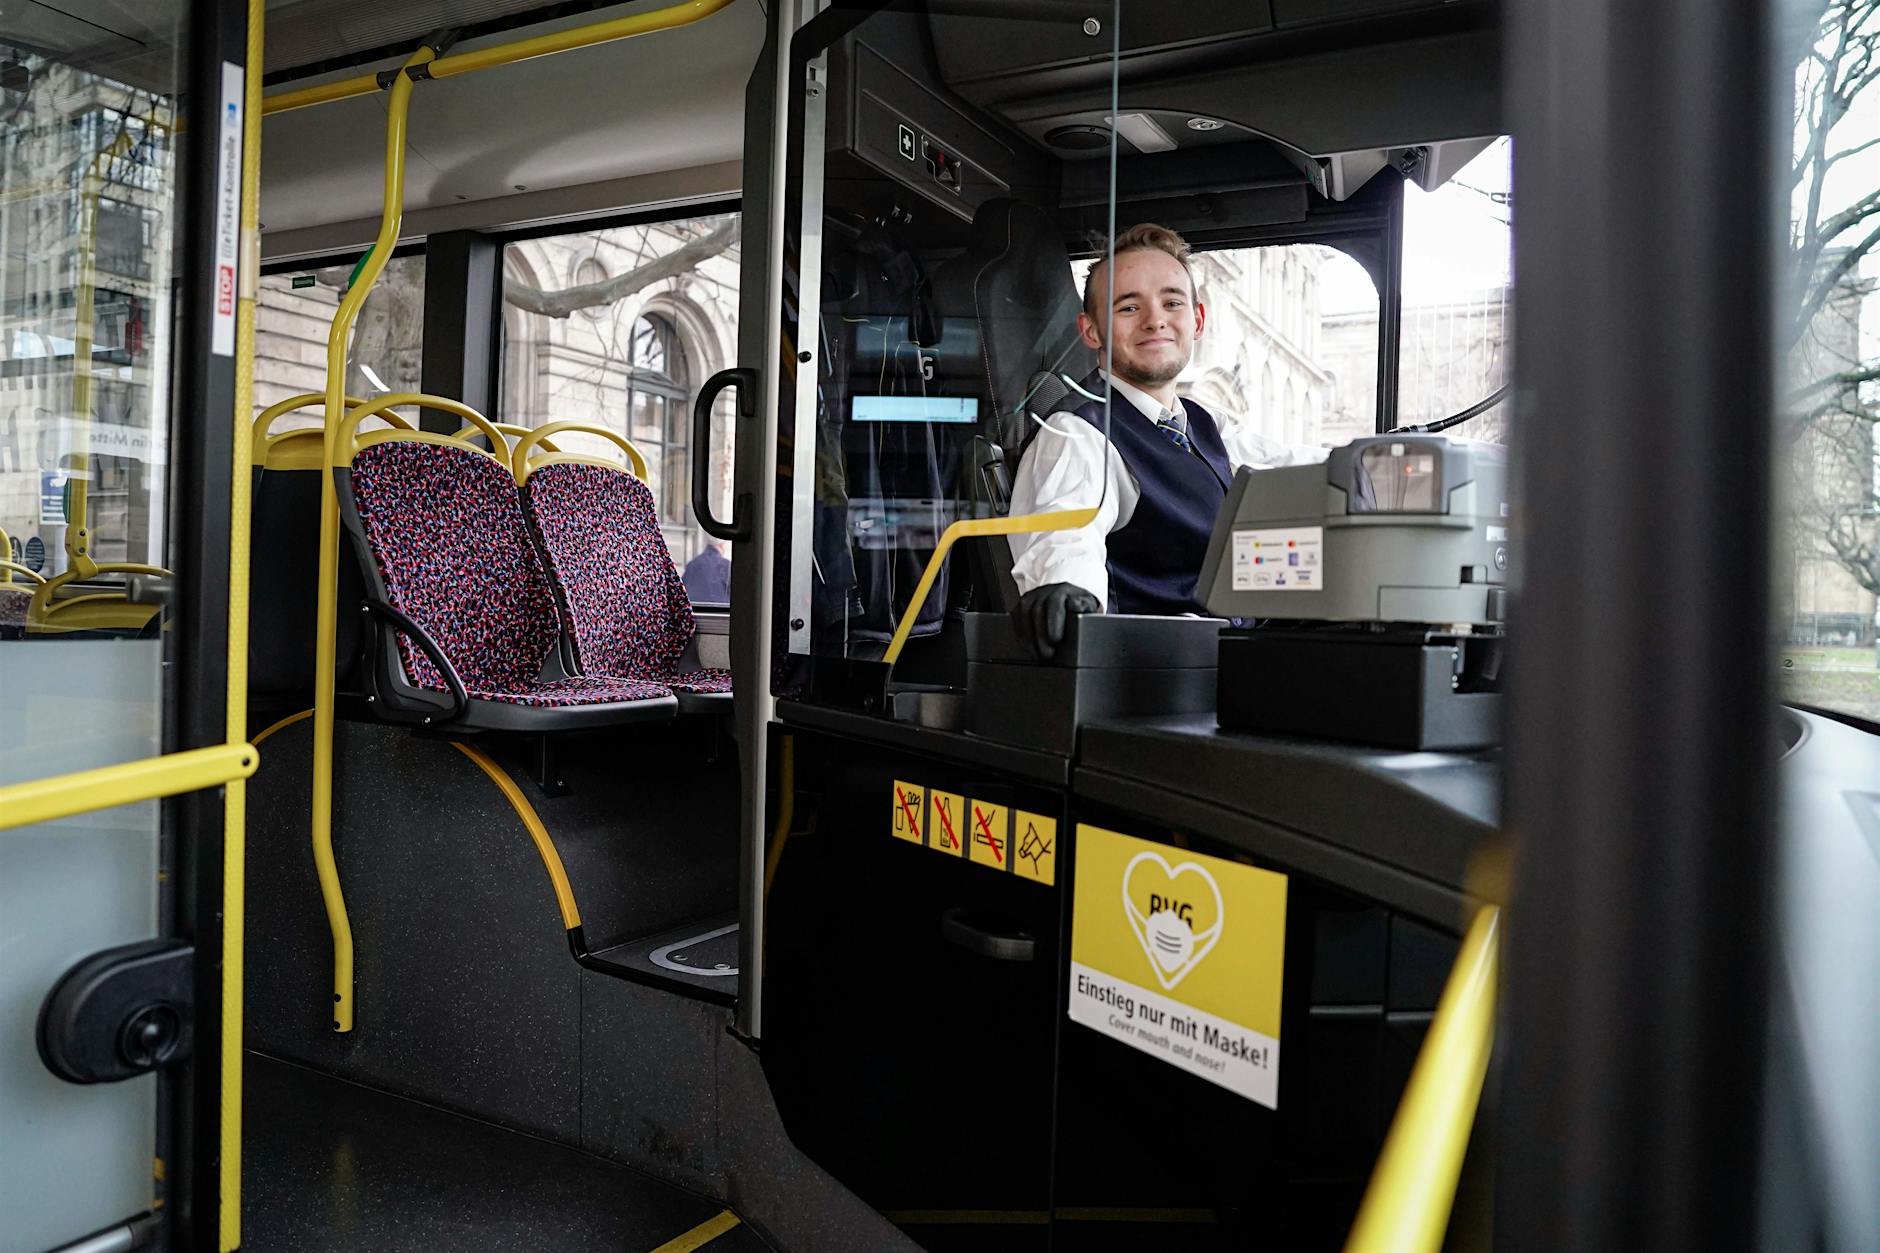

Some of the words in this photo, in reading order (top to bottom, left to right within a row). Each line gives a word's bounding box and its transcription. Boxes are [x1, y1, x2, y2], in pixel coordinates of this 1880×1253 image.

[219, 268, 232, 313] STOP
[1077, 974, 1134, 1018] Einstieg
[1139, 1002, 1166, 1026] nur
[1170, 1016, 1198, 1040] mit
[1203, 1025, 1269, 1070] Maske!
[1108, 1014, 1135, 1035] Cover
[1138, 1028, 1170, 1050] mouth
[1172, 1043, 1194, 1061] and
[1195, 1053, 1226, 1074] nose!
